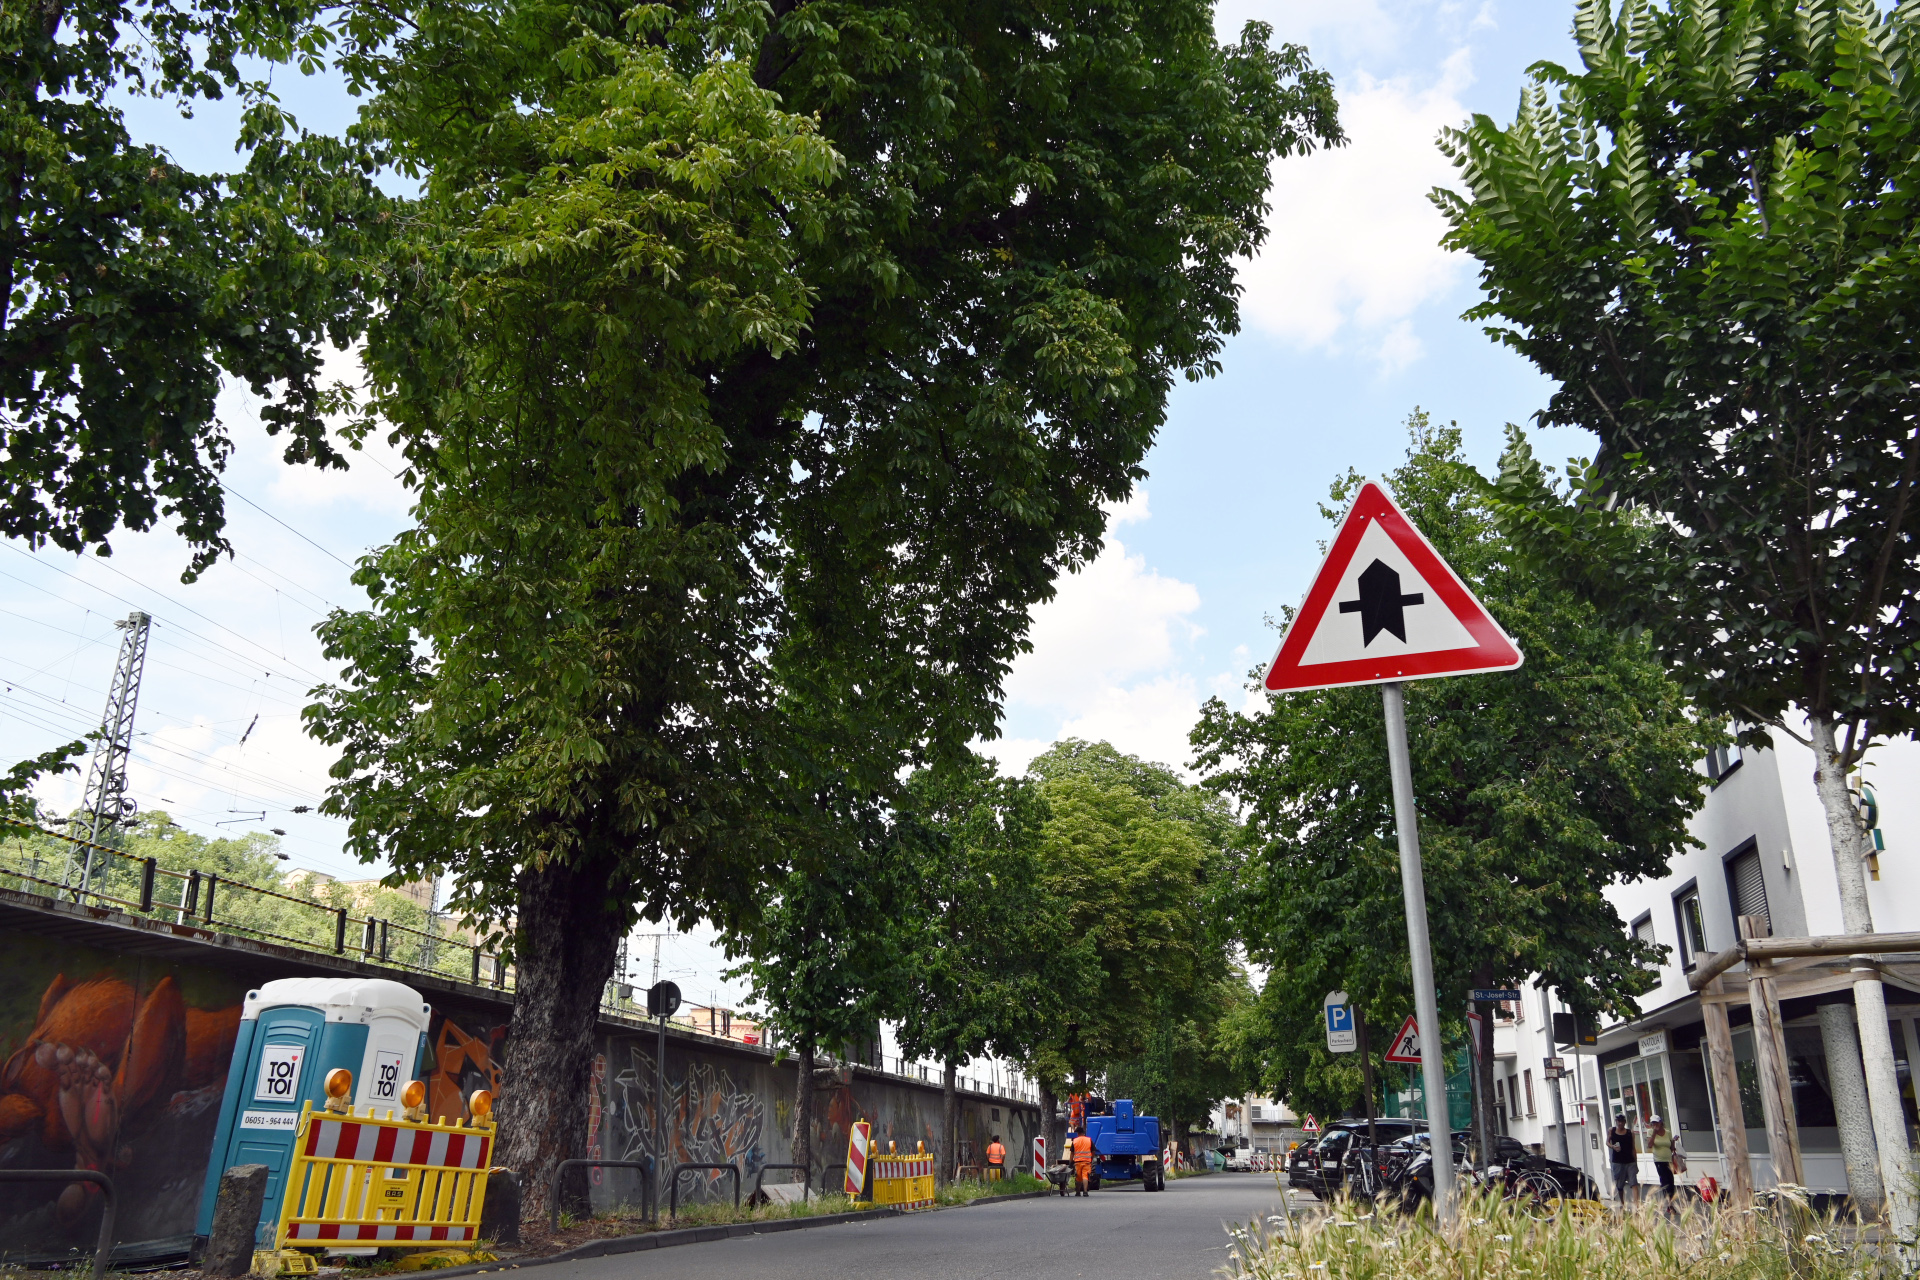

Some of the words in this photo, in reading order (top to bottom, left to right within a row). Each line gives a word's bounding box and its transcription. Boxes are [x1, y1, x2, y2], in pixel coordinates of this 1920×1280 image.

[1475, 991, 1520, 999] St.-Josef-Str.
[1332, 1007, 1346, 1028] P
[270, 1061, 295, 1078] TOI
[381, 1064, 399, 1081] TOI
[267, 1078, 292, 1095] TOI
[377, 1080, 395, 1097] TOI
[244, 1115, 265, 1125] 06051
[269, 1117, 281, 1126] 964
[282, 1117, 294, 1126] 444
